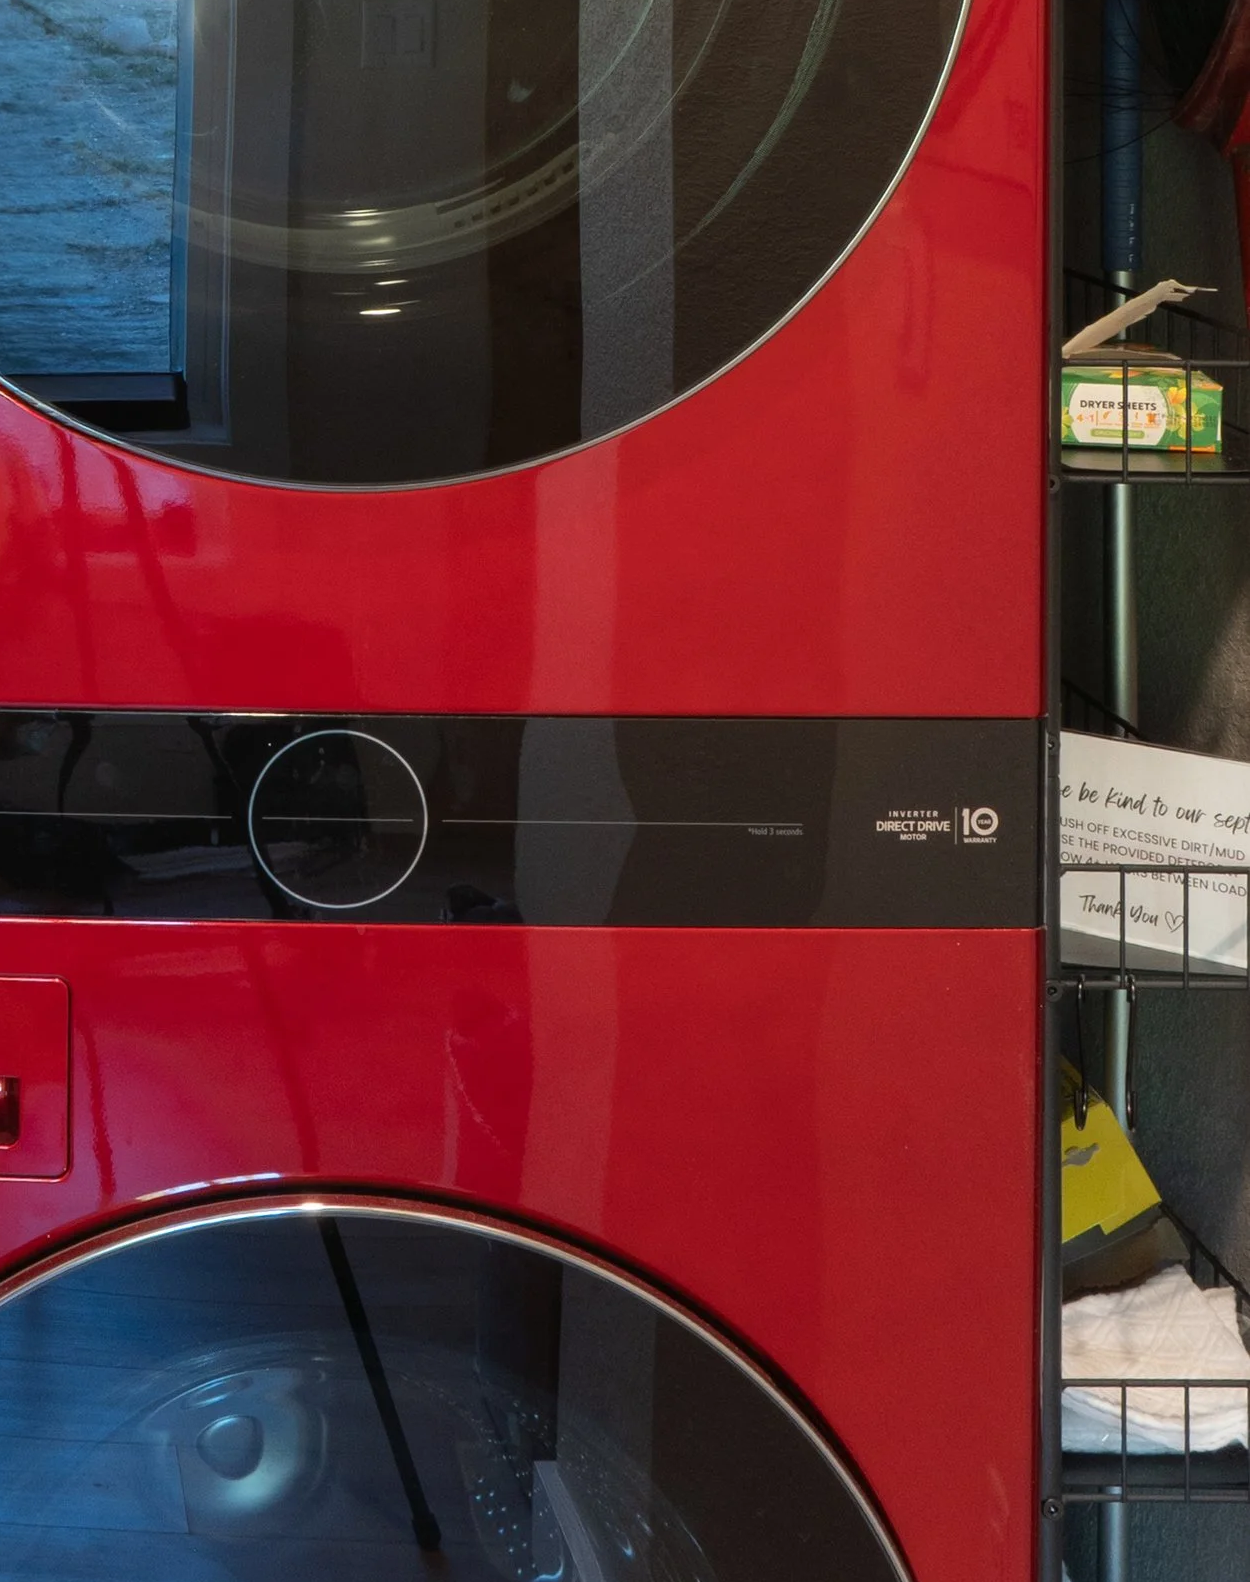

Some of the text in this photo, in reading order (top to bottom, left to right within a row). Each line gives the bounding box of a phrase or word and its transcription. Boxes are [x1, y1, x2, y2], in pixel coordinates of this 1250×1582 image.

[1080, 400, 1157, 411] DRYER SHEETS
[889, 810, 939, 818] INVERTER
[1078, 781, 1100, 804] be
[1153, 796, 1168, 818] to
[1175, 807, 1206, 824] our
[876, 821, 951, 832] DIRECT DRIVE
[962, 807, 999, 836] 10
[1078, 837, 1100, 852] THE
[1103, 843, 1164, 864] PROVIDED
[1087, 822, 1109, 835] OFF
[1113, 827, 1177, 849] EXCESSIVE
[1181, 840, 1246, 861] DIRT/MUD
[1078, 894, 1121, 918] Thank
